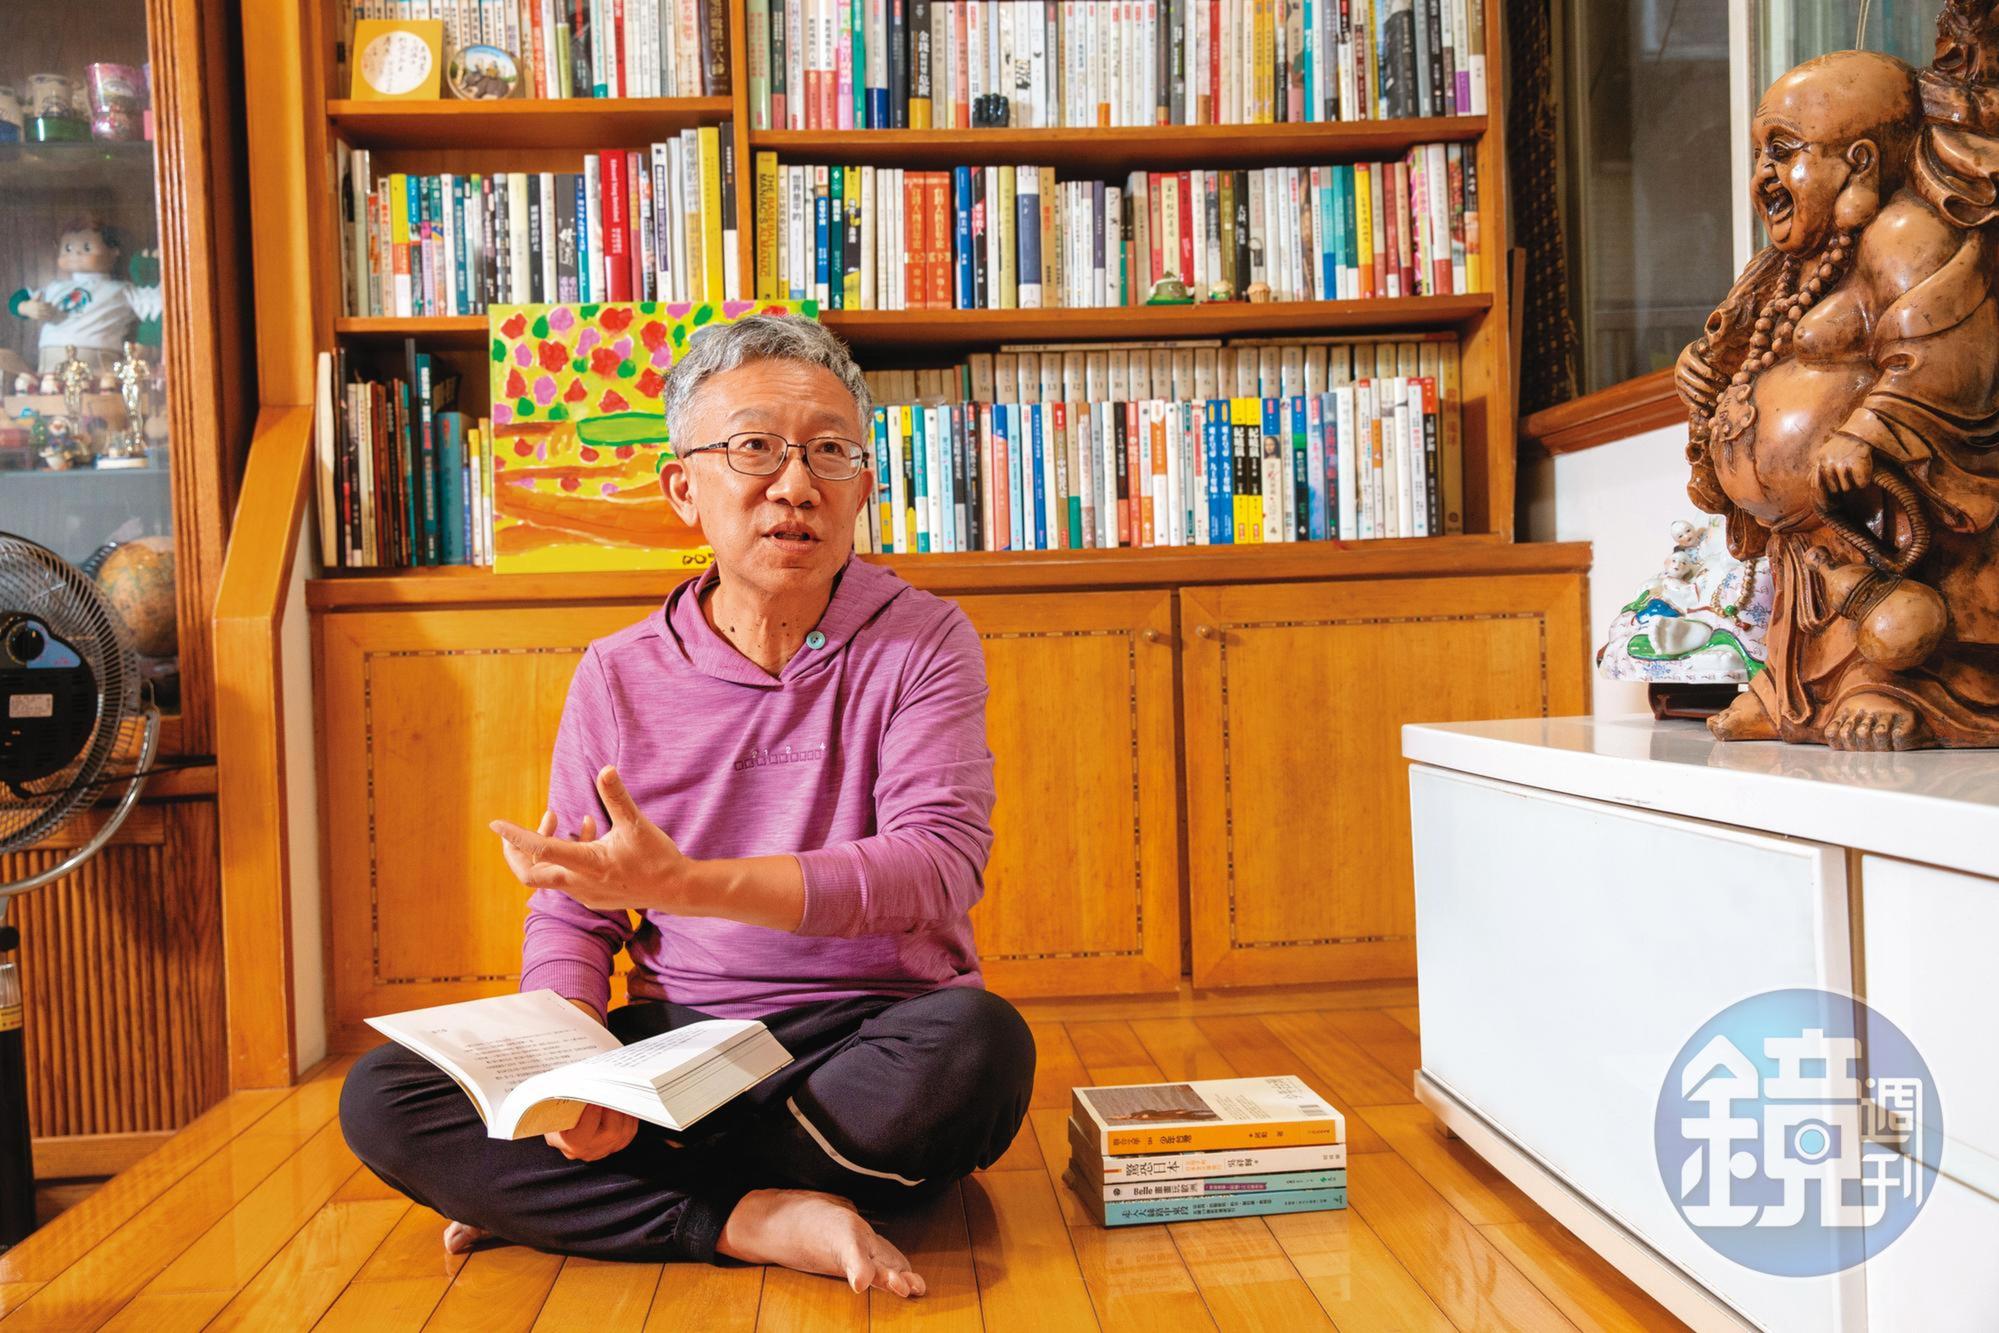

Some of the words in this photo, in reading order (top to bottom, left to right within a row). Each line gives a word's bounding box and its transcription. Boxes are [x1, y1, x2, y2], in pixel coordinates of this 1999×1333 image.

[758, 172, 768, 225] MANIAC'S
[766, 173, 775, 193] THE
[766, 196, 775, 249] BASEBALL
[758, 226, 768, 278] ALMANAC
[1125, 1160, 1181, 1177] 驚恐日本
[1133, 1186, 1153, 1196] Belle
